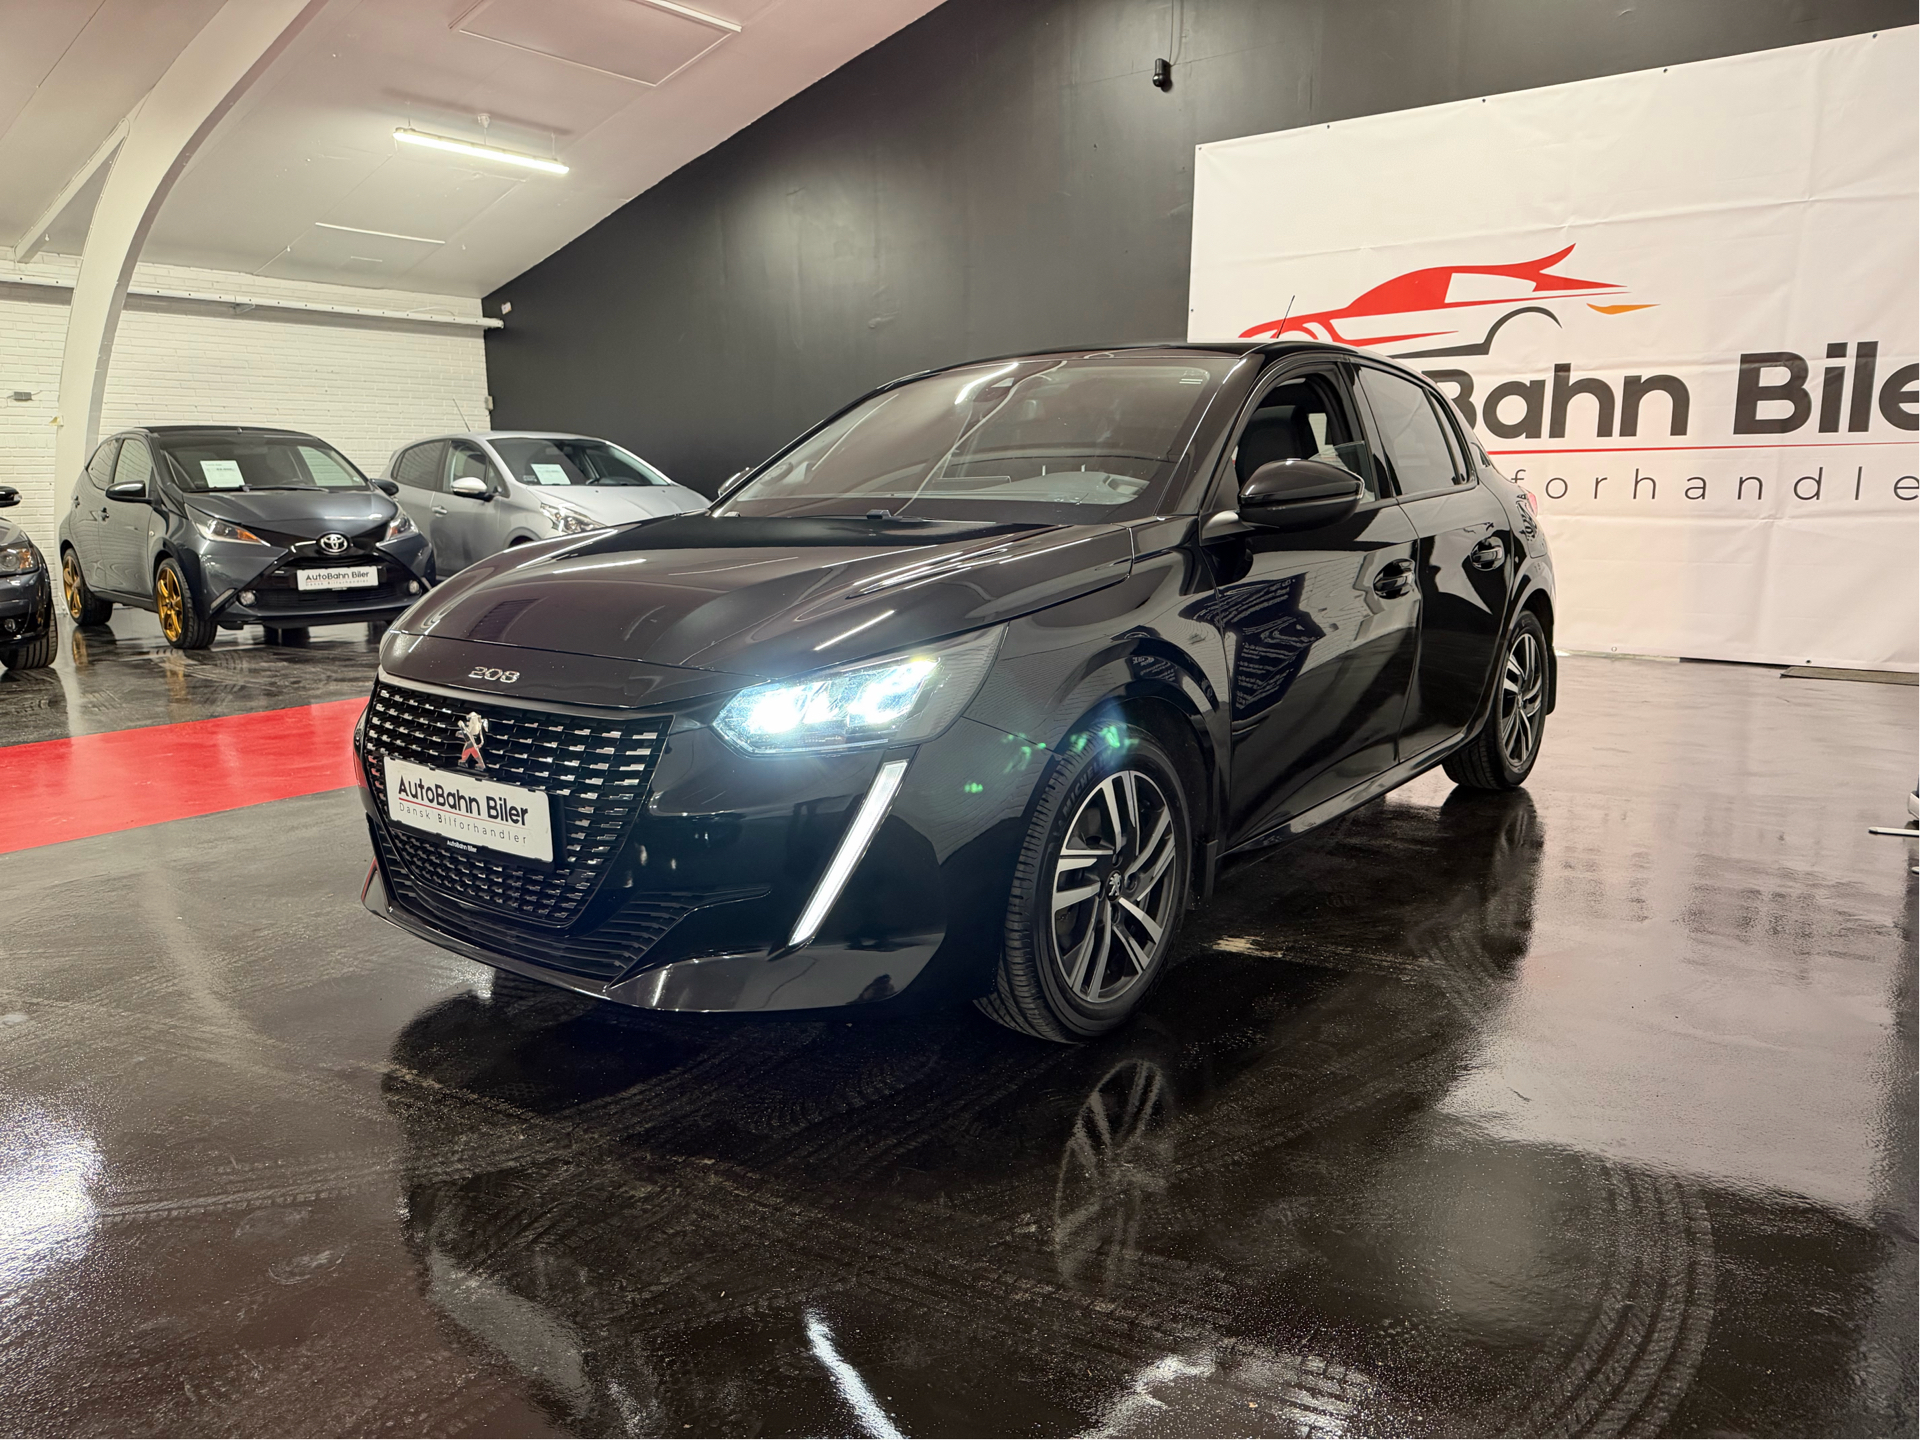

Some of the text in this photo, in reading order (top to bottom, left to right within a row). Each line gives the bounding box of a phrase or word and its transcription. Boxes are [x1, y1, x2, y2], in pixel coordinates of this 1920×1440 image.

[306, 570, 370, 581] AutoBahn Biler
[468, 666, 520, 683] 208
[398, 775, 529, 826] AutoBahn Biler
[399, 802, 527, 845] Dansk Bilforhandler
